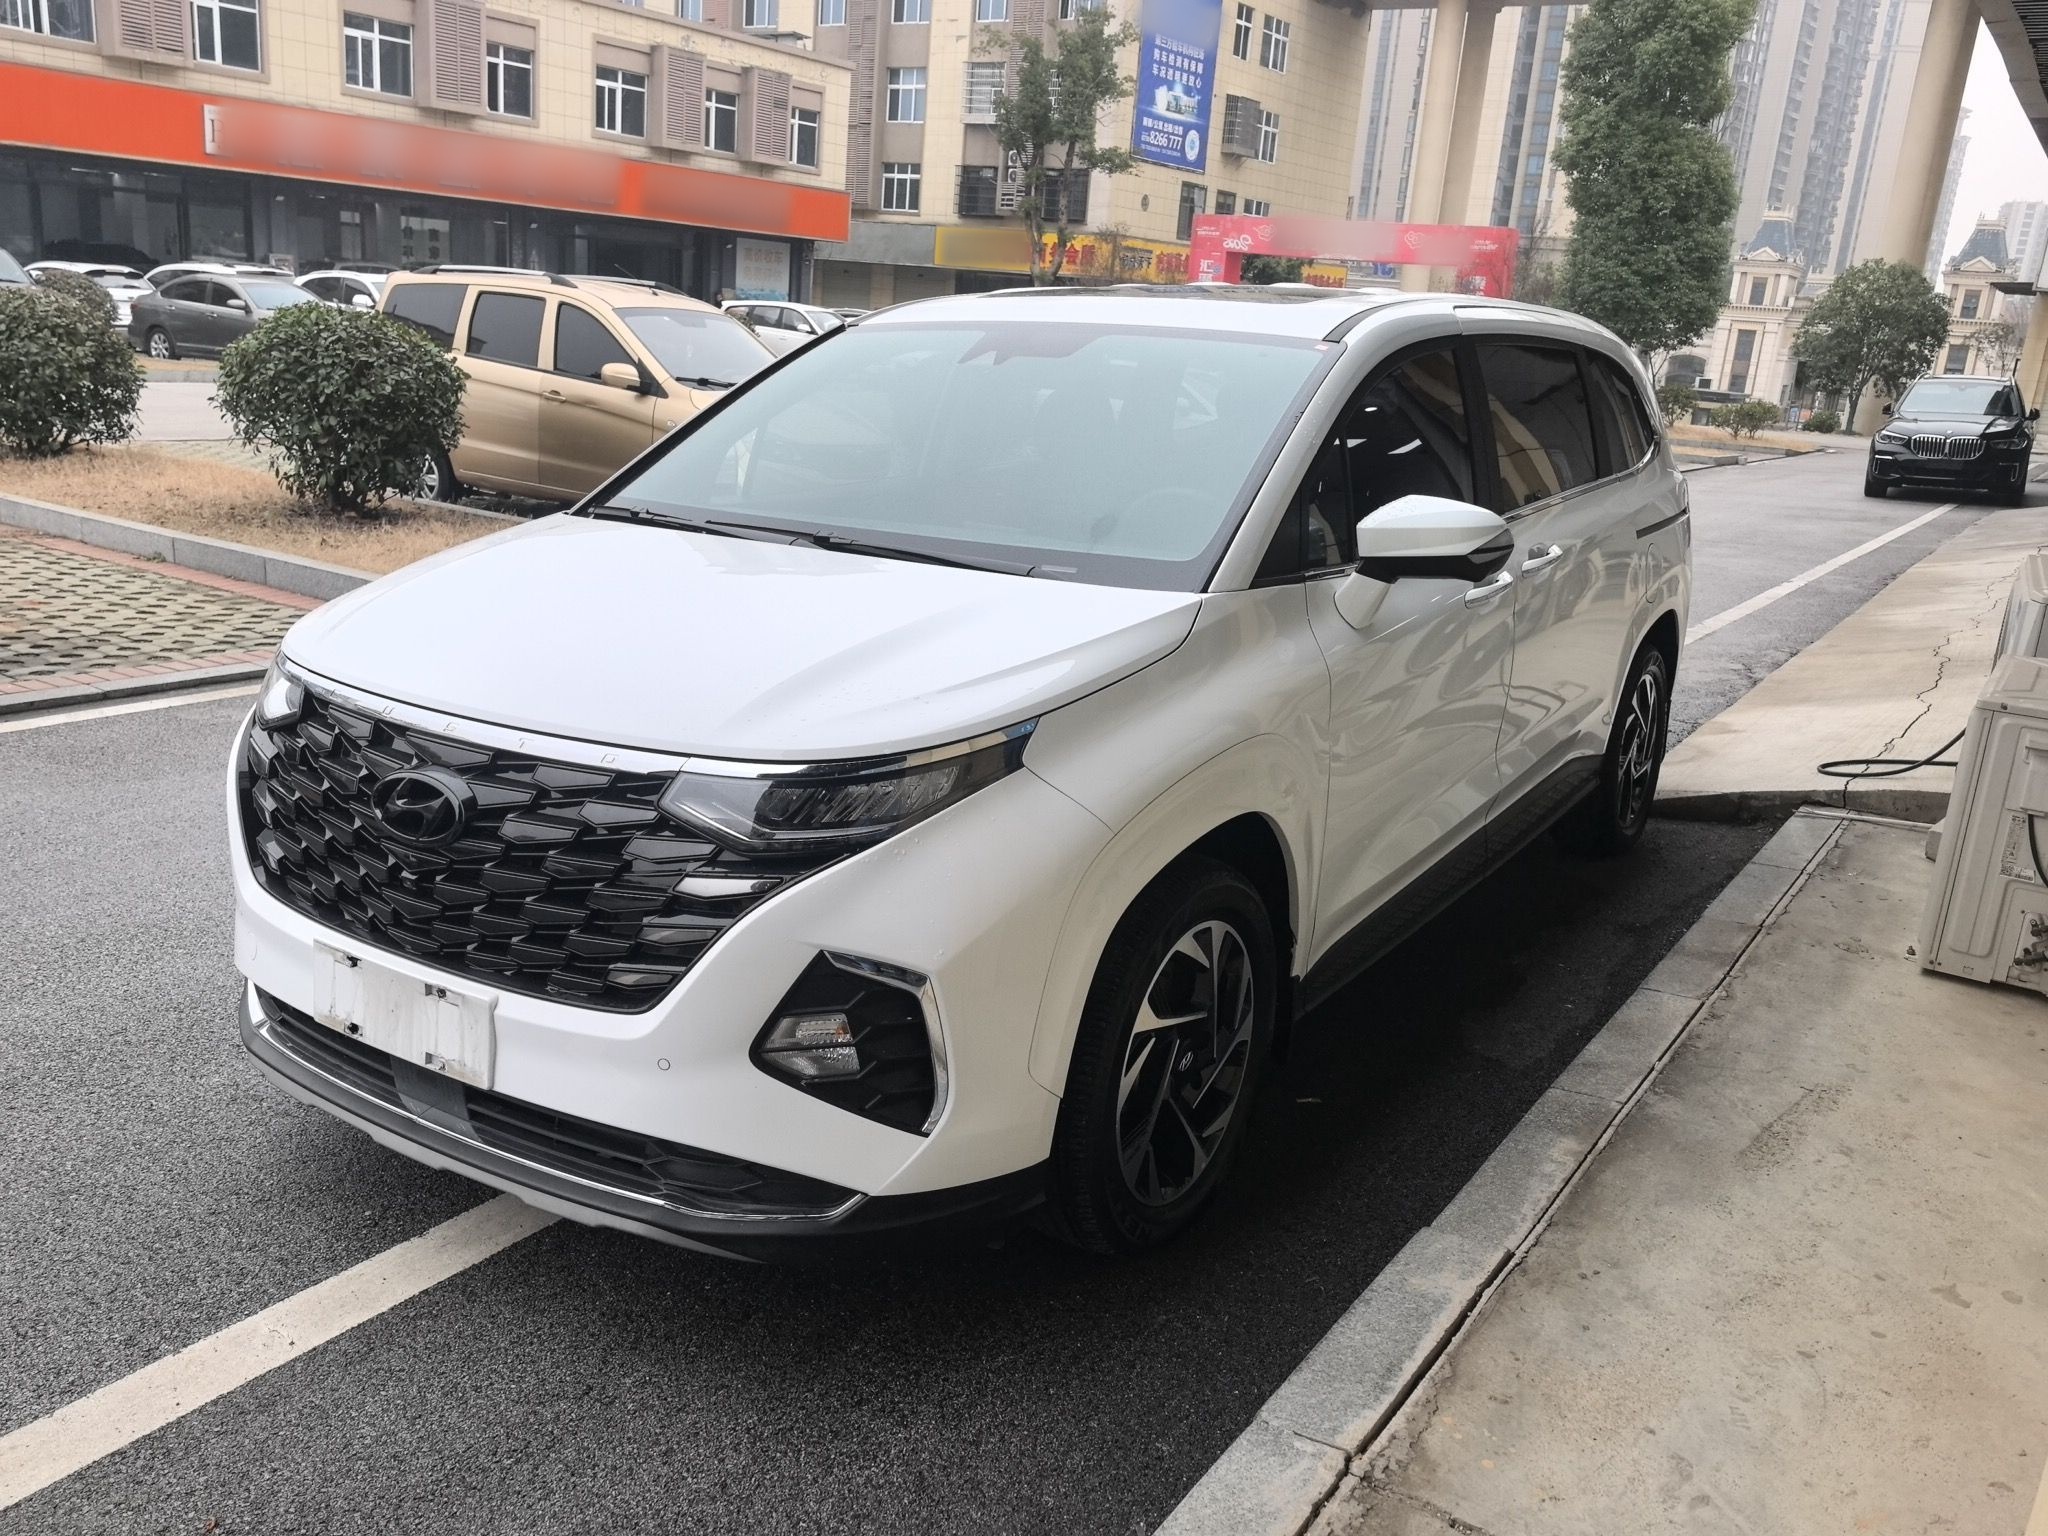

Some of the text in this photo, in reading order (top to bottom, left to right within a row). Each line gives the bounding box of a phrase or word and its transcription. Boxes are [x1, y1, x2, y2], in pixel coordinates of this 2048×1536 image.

[1153, 47, 1204, 75] 购车检测有保障
[1152, 63, 1202, 89] 车况透明更放心
